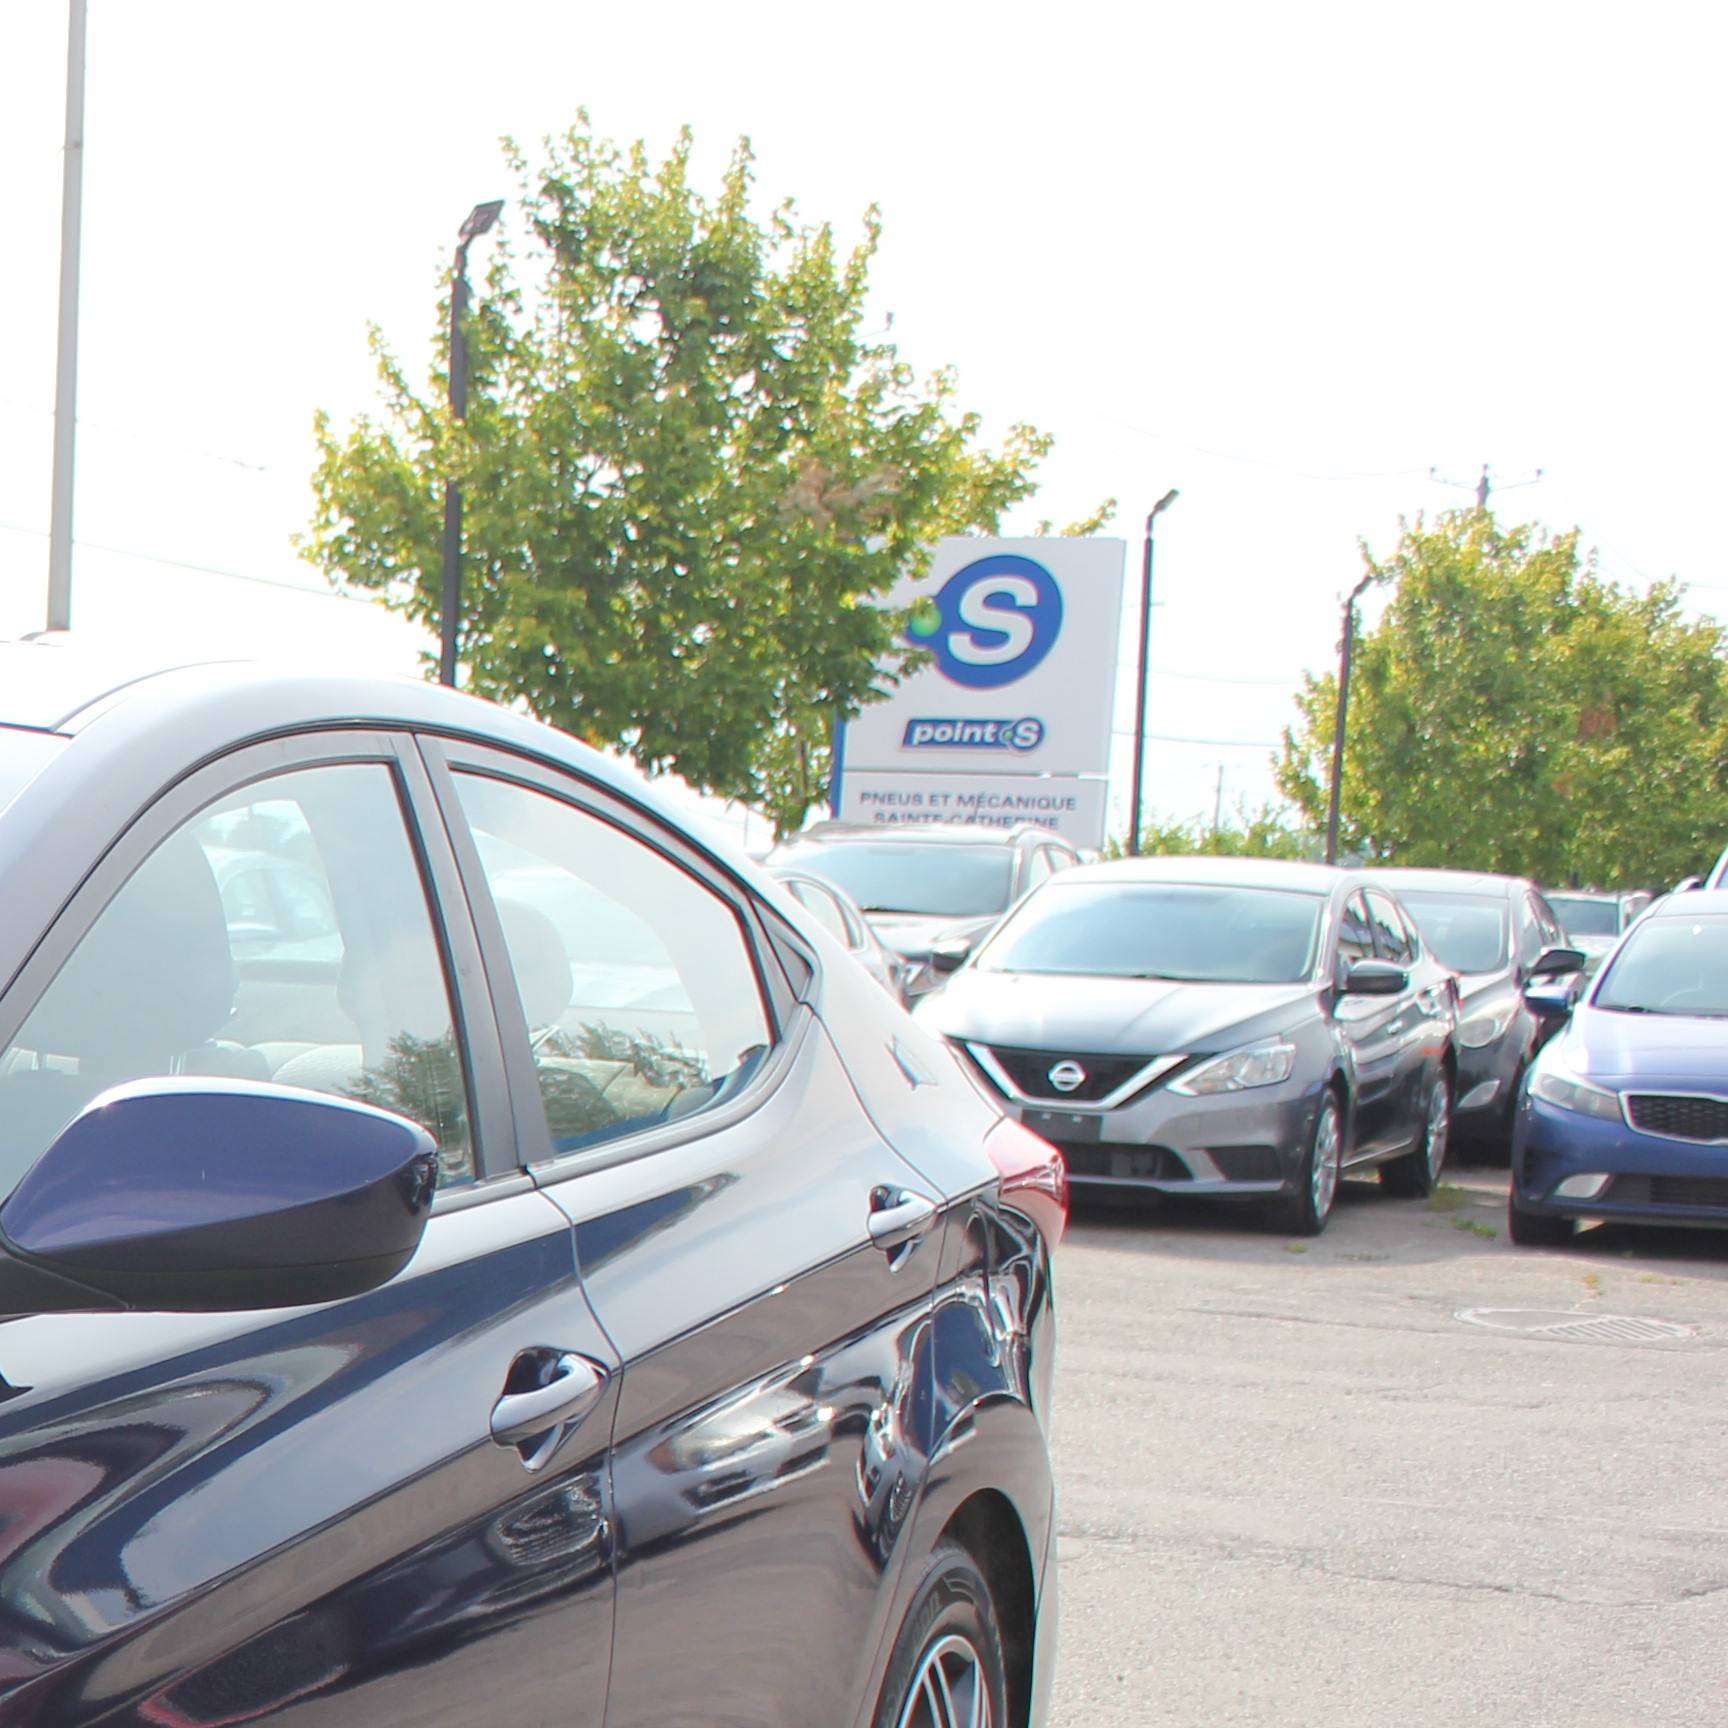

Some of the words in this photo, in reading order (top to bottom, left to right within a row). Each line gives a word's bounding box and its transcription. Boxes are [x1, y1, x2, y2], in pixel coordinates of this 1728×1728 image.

[948, 575, 1039, 666] S
[911, 721, 997, 746] point
[859, 791, 923, 806] PNEUS
[928, 794, 953, 807] ET
[955, 791, 1077, 811] MÉCANIQUE
